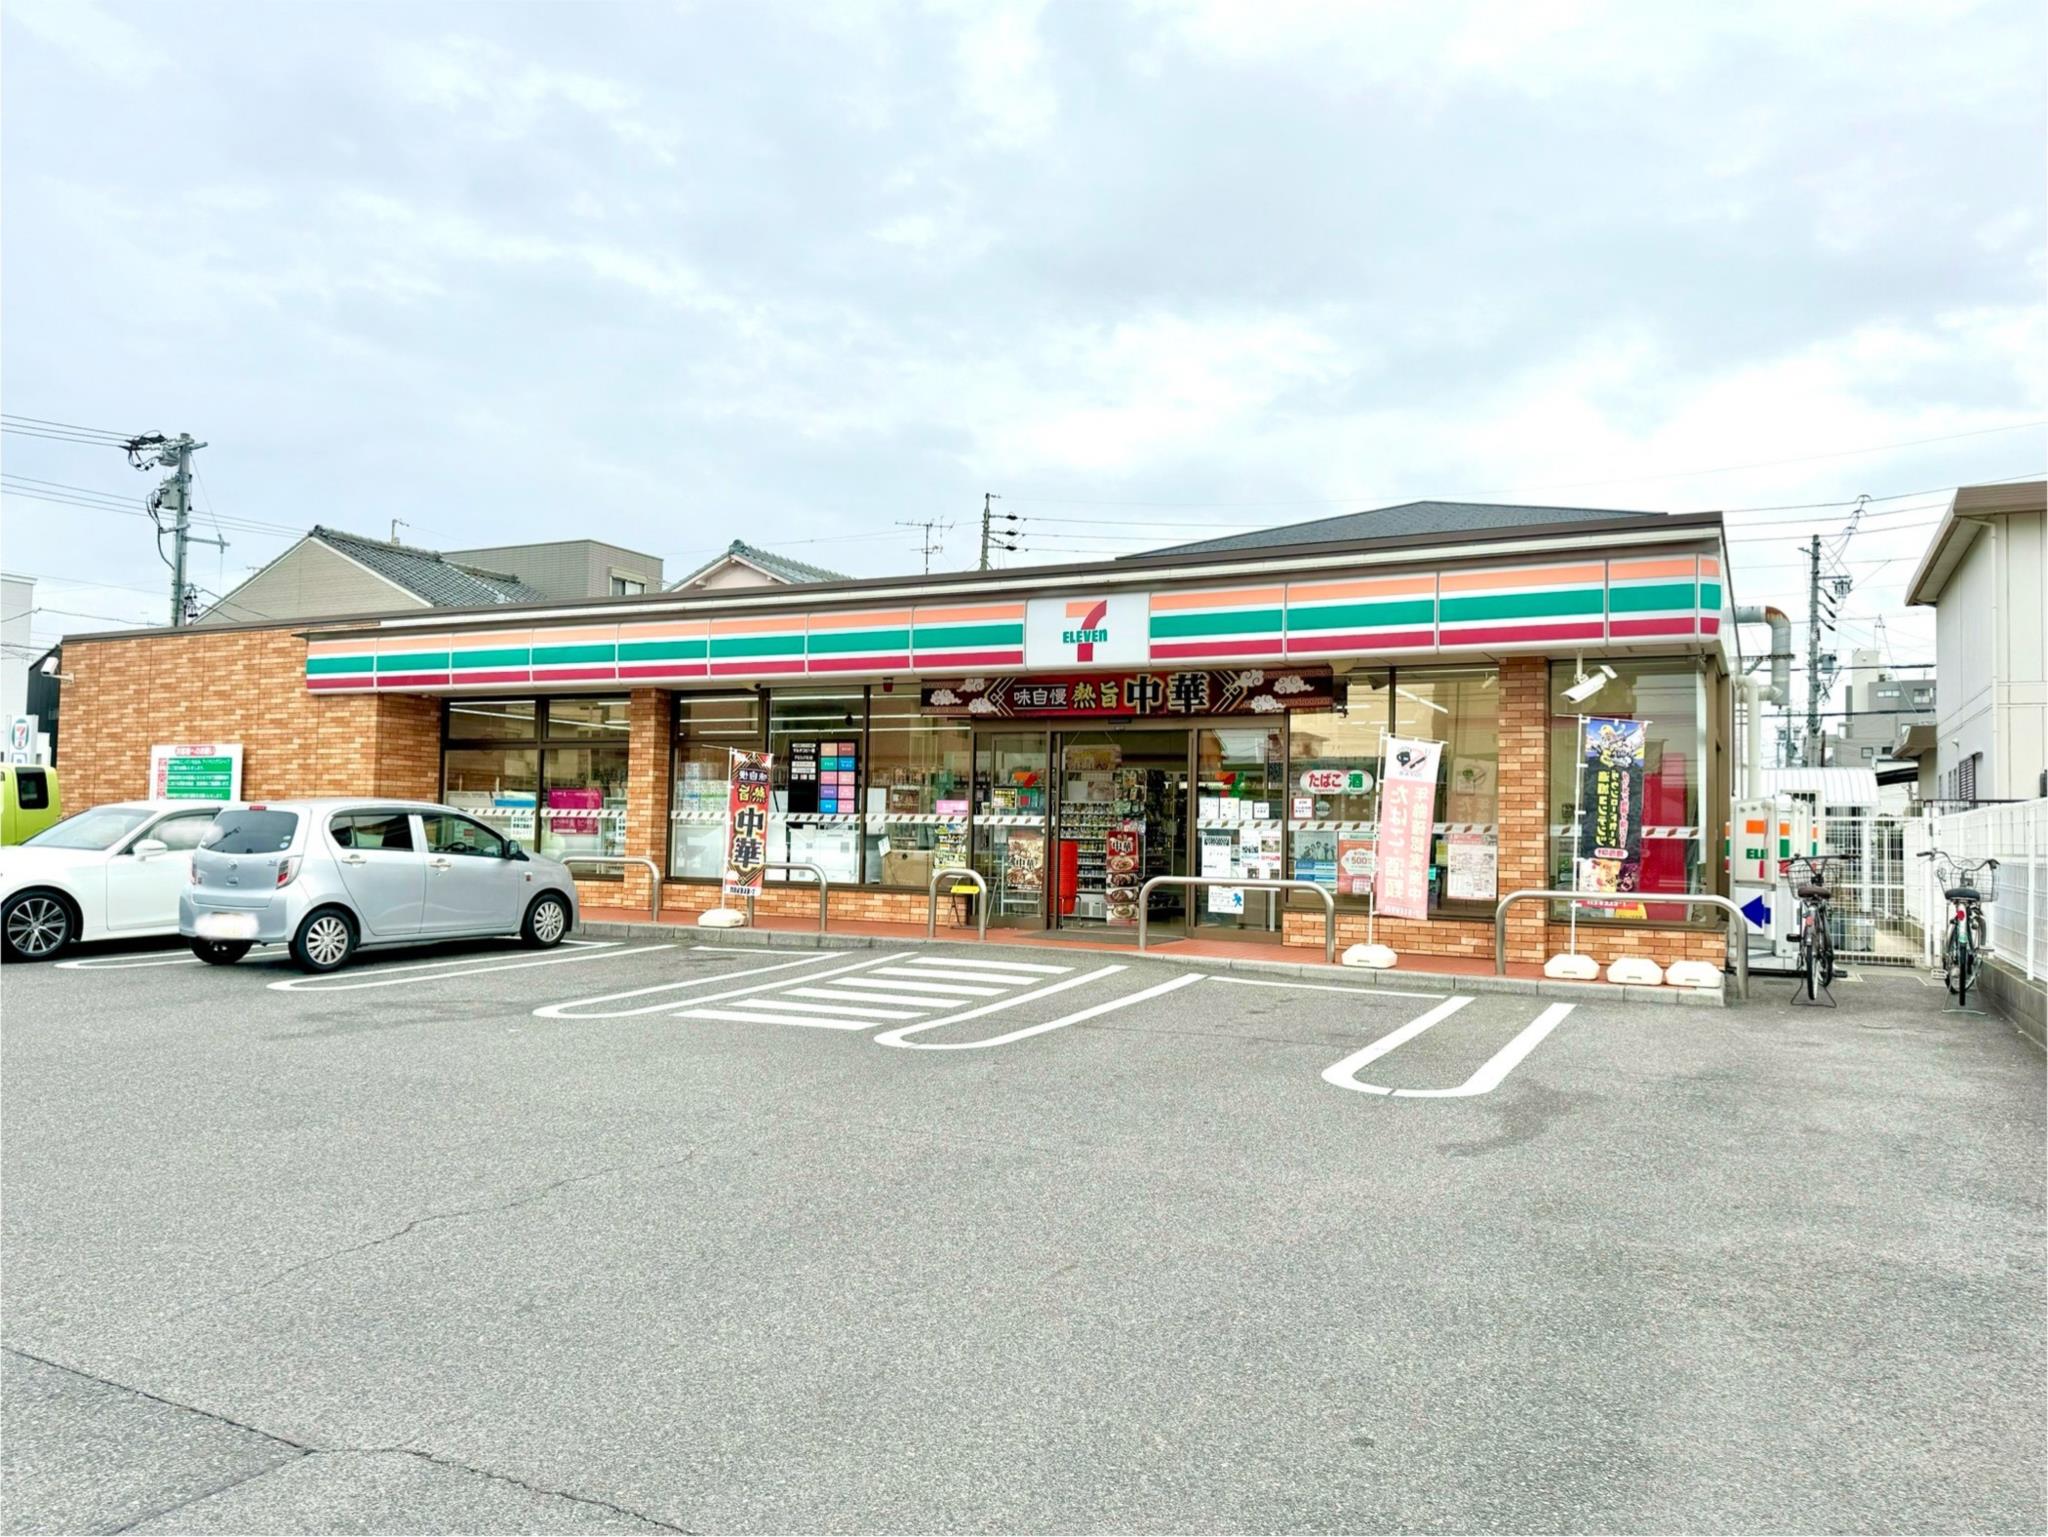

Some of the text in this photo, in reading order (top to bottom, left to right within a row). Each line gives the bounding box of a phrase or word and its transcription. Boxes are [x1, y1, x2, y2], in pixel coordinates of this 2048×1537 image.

[1013, 672, 1211, 714] 味自慢 熱旨 中華
[1309, 773, 1342, 788] たばこ
[1348, 773, 1363, 788] 酒
